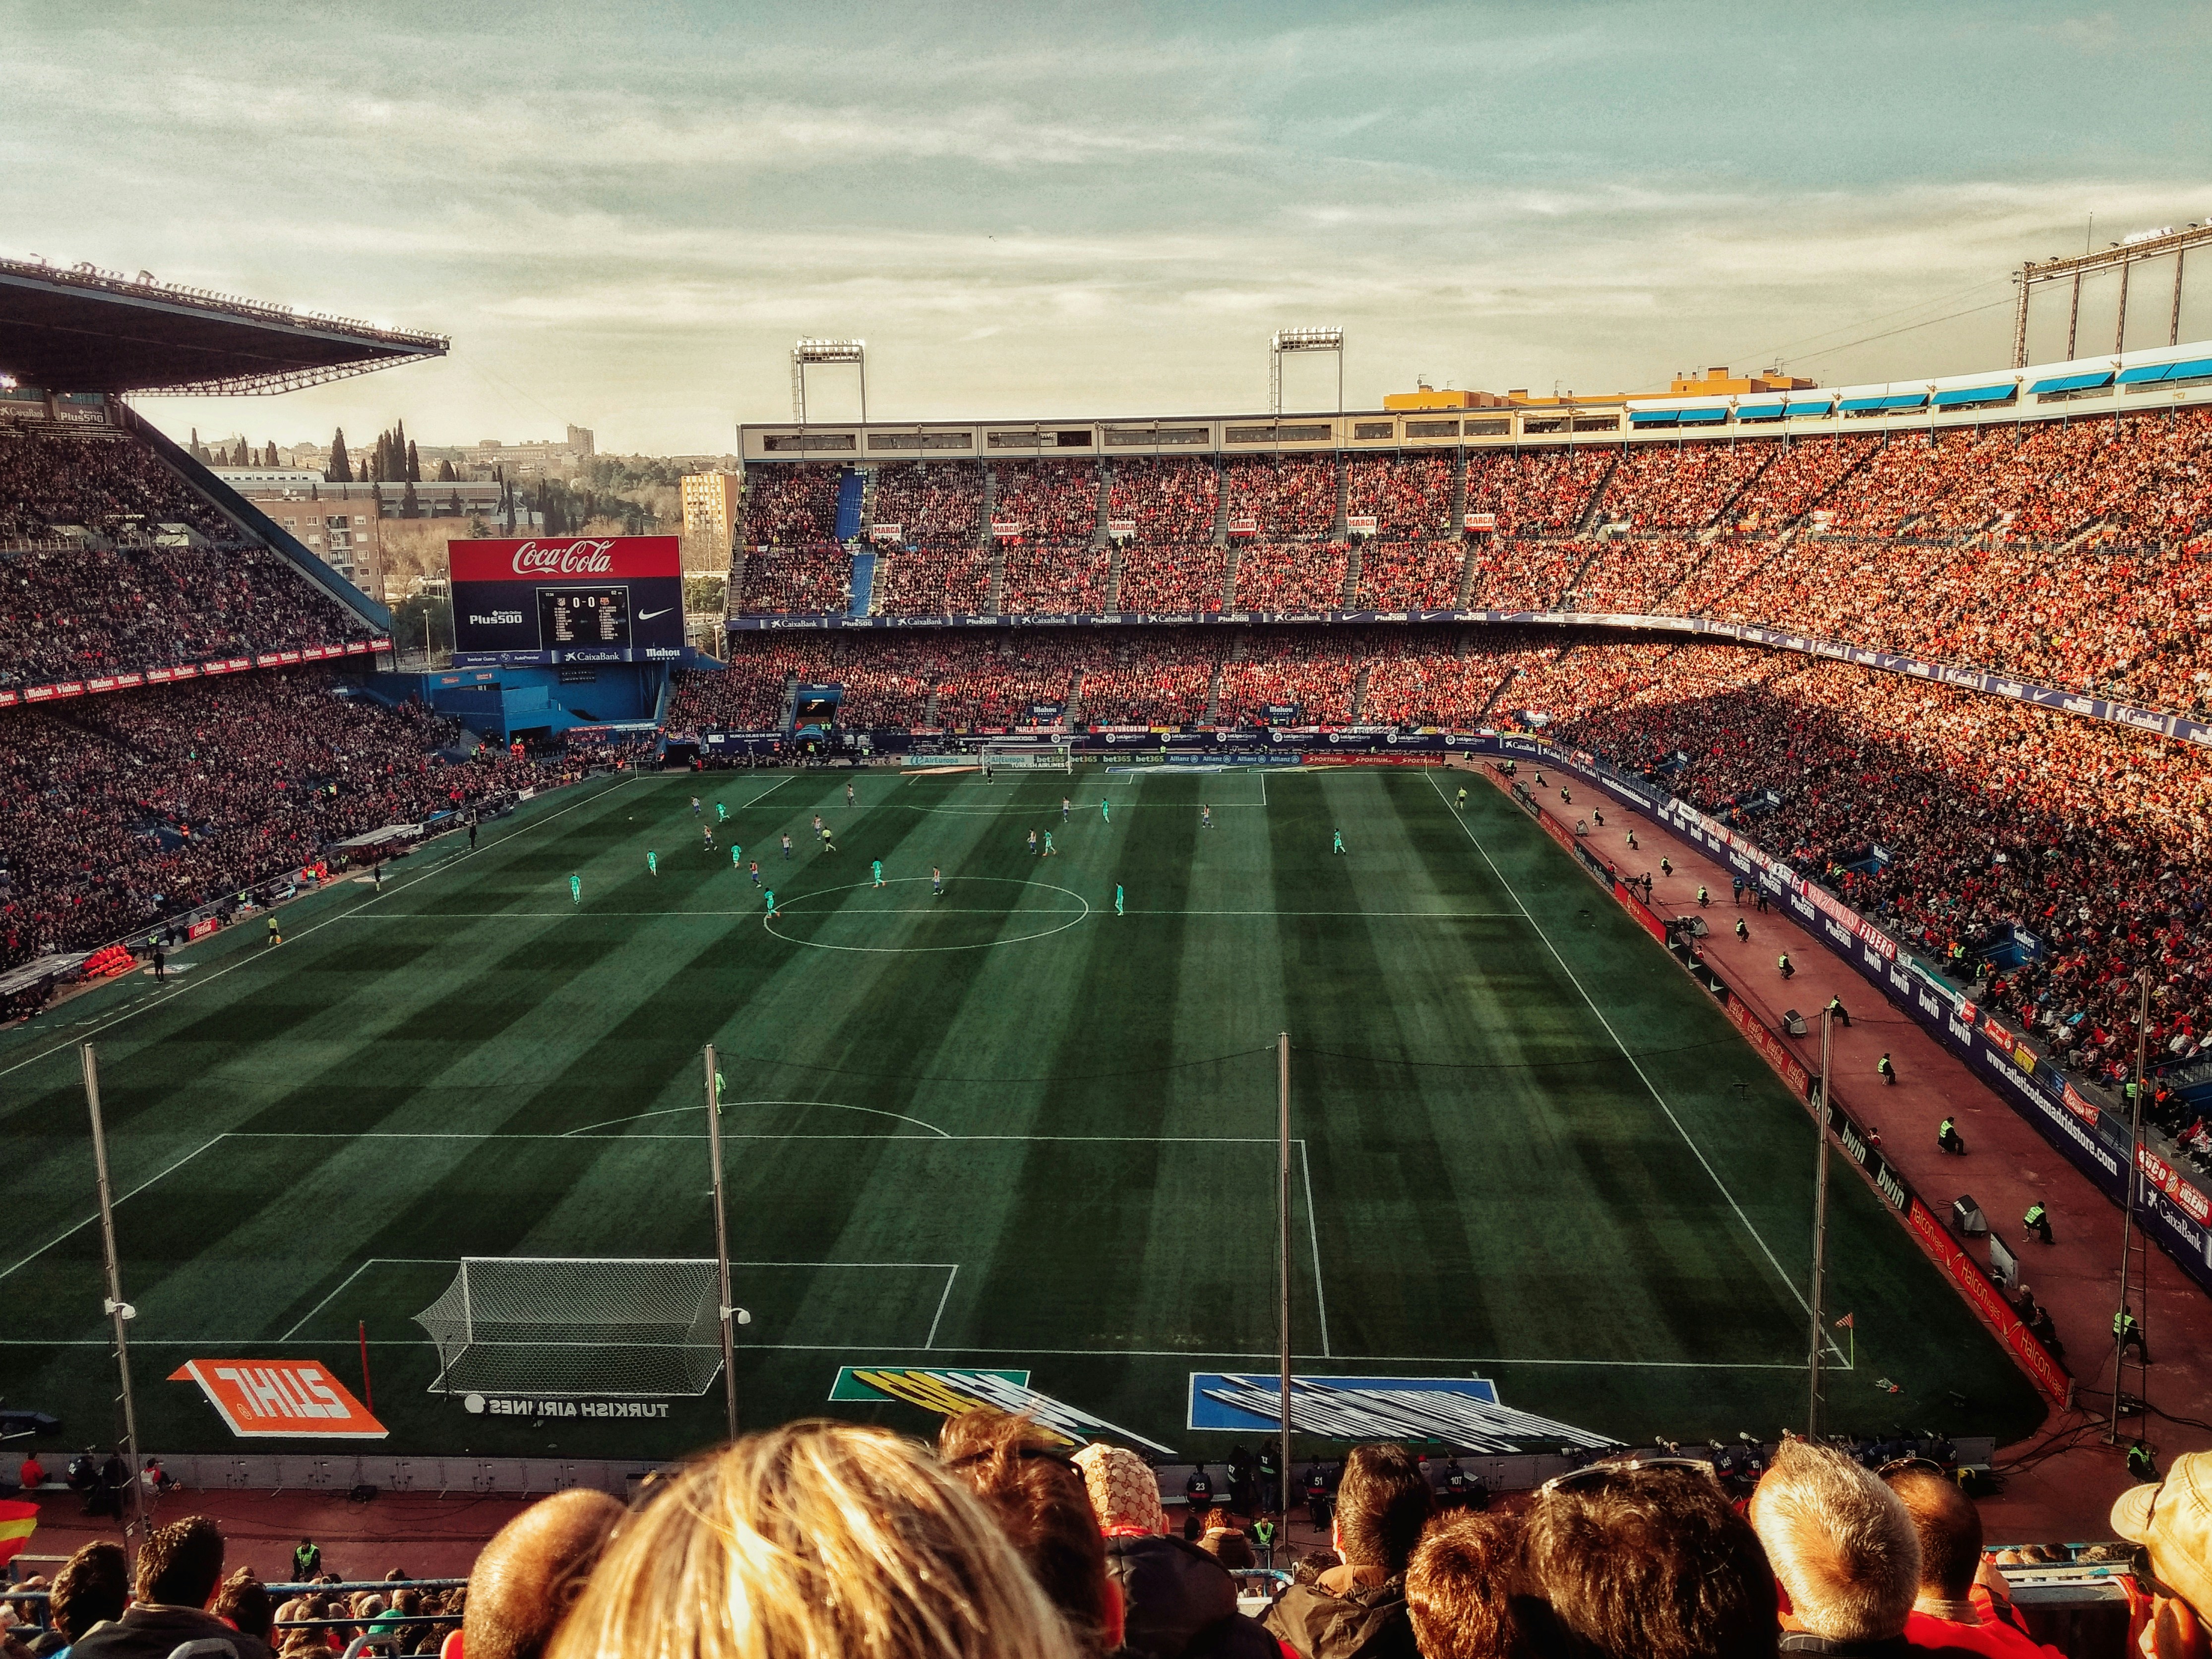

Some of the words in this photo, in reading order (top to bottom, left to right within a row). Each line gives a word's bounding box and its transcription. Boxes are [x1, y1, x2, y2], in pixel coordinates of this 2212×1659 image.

[10, 407, 45, 418] CaixaBank
[1229, 521, 1255, 529] MARCA
[512, 540, 616, 574] Coca-Cola
[573, 597, 580, 608] 0
[588, 597, 595, 608] 0
[469, 614, 523, 624] Plus500
[280, 652, 299, 661] Mahou
[577, 652, 619, 661] CaixaBank
[646, 648, 680, 657] Mahou
[174, 666, 194, 676] Mahou
[206, 662, 226, 671] Mahou
[229, 659, 248, 668] Mahou
[91, 677, 114, 688] Mahou
[118, 675, 140, 684] Mahou
[149, 670, 171, 679] Mahou
[28, 687, 53, 698] Mahou
[2126, 709, 2163, 731] CaixaBank
[1513, 741, 1536, 752] CaixaBank
[1658, 803, 1669, 821] bwin
[1673, 813, 1685, 831] bwin
[1690, 823, 1702, 842] bwin
[1708, 835, 1720, 853] bwin
[1729, 851, 1750, 874] Plus500
[1760, 871, 1782, 896] Plus500
[1791, 894, 1814, 921] Plus500
[194, 920, 212, 936] Coca-Cola
[1826, 919, 1851, 949] Plus500
[1864, 944, 1881, 972] bwin
[1890, 966, 1909, 995] bwin
[1729, 997, 1744, 1022] Coca-Cola
[1919, 988, 1939, 1019] bwin
[1748, 1016, 1764, 1044] Coca-Cola
[1949, 1012, 1970, 1046] bwin
[1767, 1037, 1784, 1065] Coca-Cola
[1787, 1060, 1805, 1090] Coca-Cola
[1986, 1049, 2117, 1176] www.atleticodemadridstore.com
[1842, 1121, 1866, 1165] bwin
[1877, 1162, 1904, 1209] bwin
[2179, 1186, 2209, 1219] UGENA
[2160, 1200, 2201, 1253] CaixaBank
[1720, 1456, 1732, 1469] 146
[1751, 1460, 1760, 1469] 18
[1315, 1476, 1323, 1486] 51
[1451, 1476, 1462, 1485] 107
